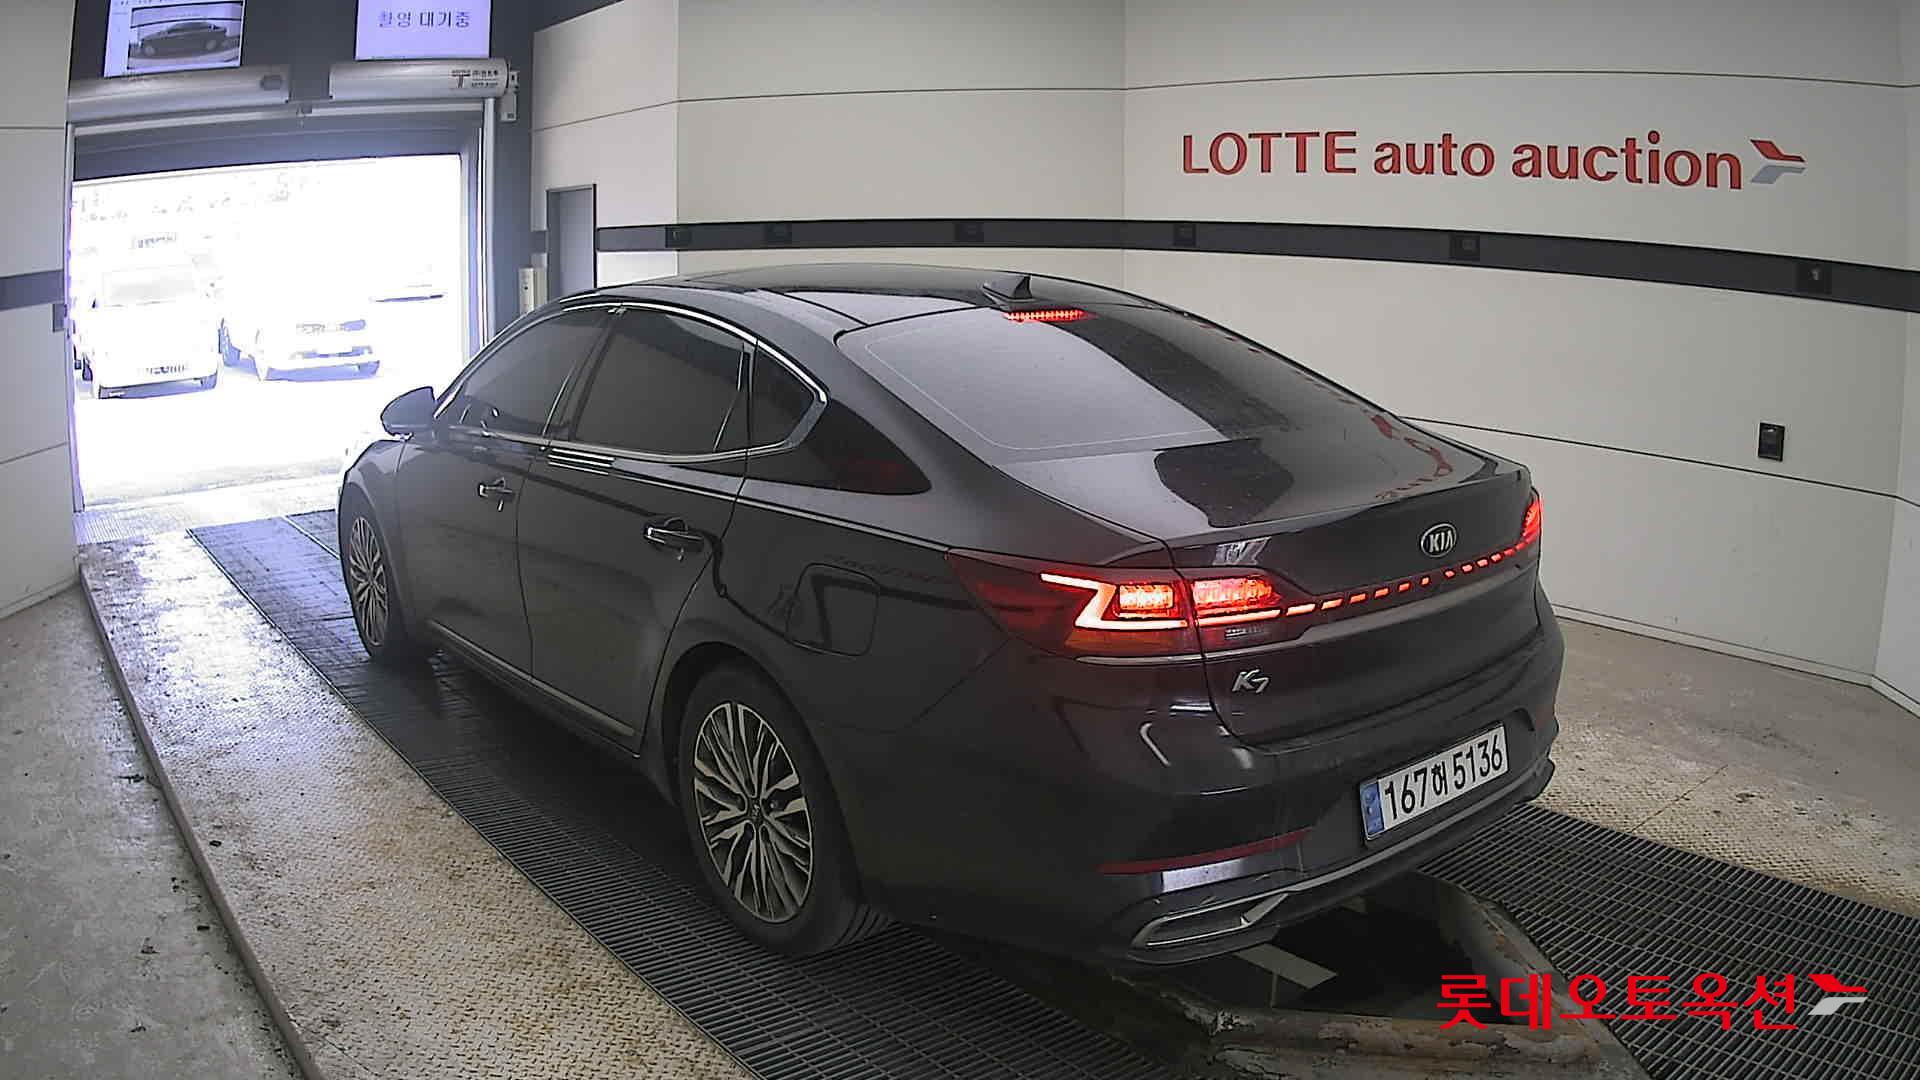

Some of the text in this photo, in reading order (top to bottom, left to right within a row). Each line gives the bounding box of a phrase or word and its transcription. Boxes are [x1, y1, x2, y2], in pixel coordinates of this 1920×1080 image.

[419, 11, 469, 28] 대기중
[1183, 130, 1743, 190] LOTTE auto auction
[1426, 528, 1455, 554] KIA
[1231, 668, 1270, 694] K7
[1452, 734, 1503, 790] 5136
